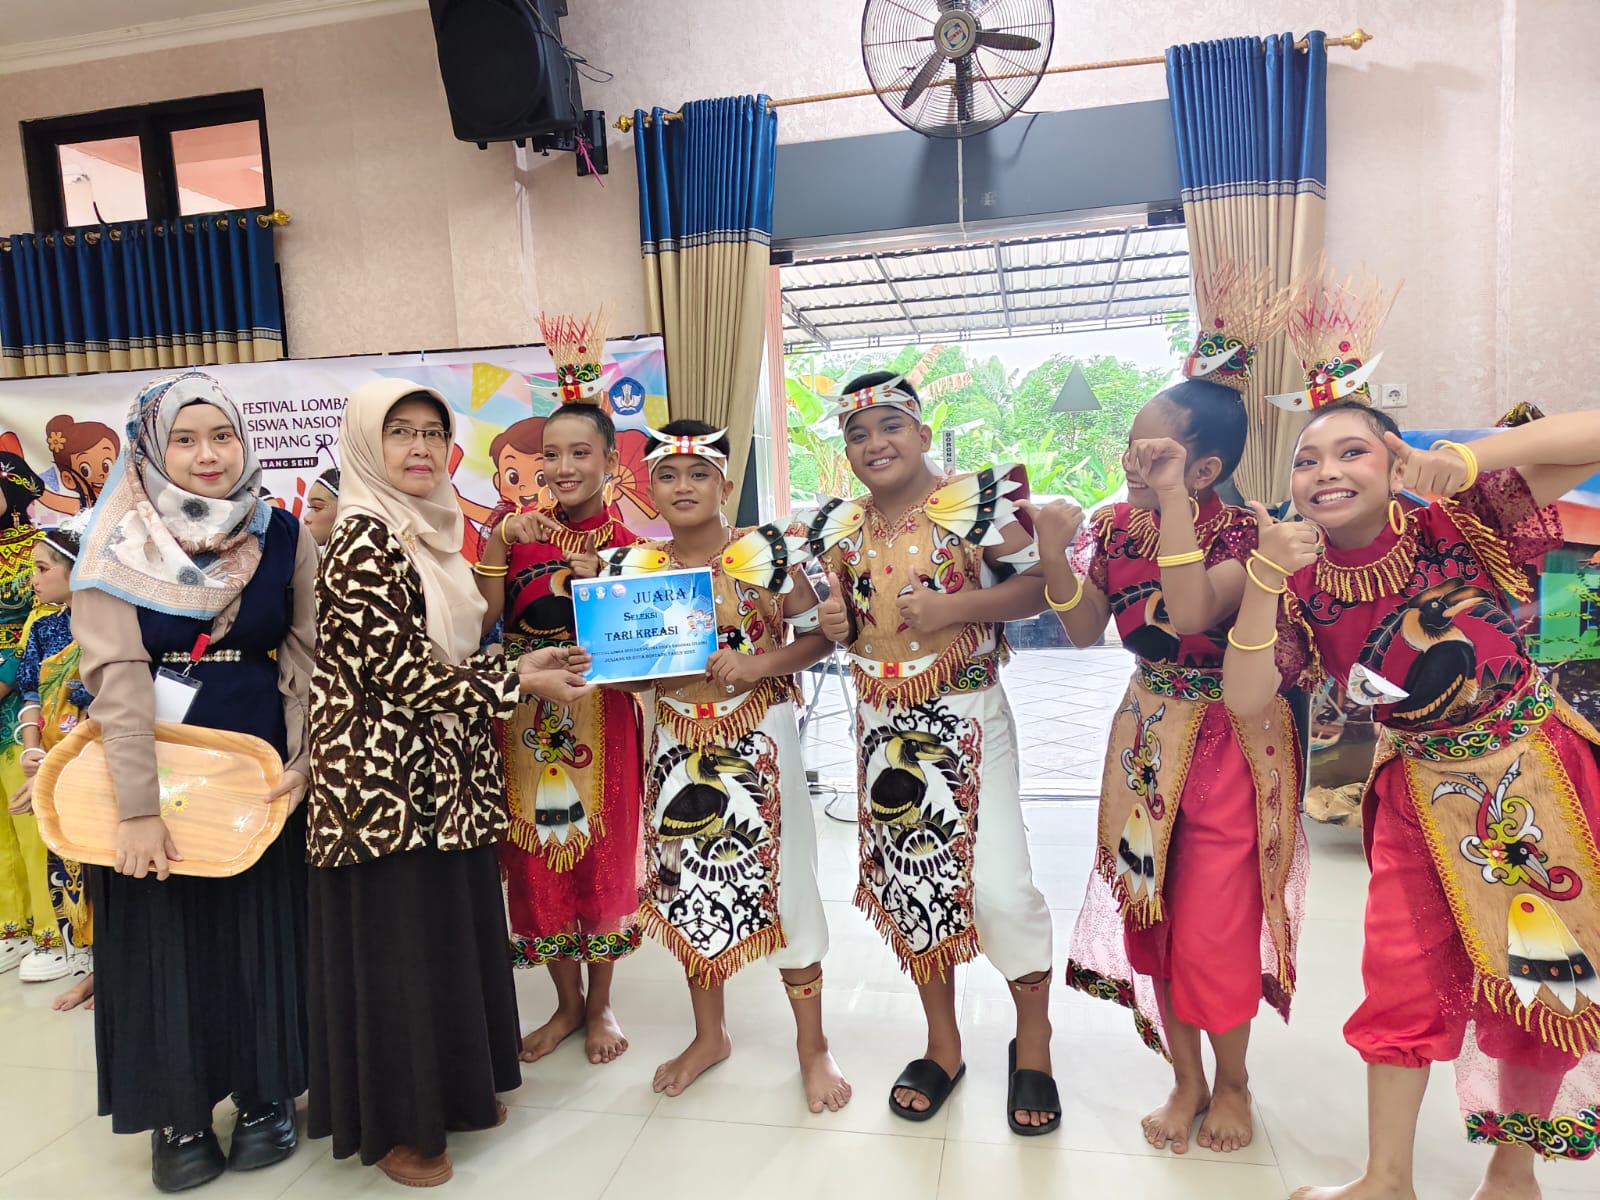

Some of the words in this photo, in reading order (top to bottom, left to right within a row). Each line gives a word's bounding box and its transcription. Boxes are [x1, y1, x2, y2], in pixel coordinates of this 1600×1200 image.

[242, 400, 298, 415] FESTIVAL
[247, 418, 289, 432] SISWA
[253, 434, 311, 452] JENJANG
[261, 459, 289, 468] BANG
[291, 458, 314, 467] SENI
[633, 587, 686, 605] JUARA
[604, 630, 633, 642] TARI
[635, 625, 679, 639] KREASI
